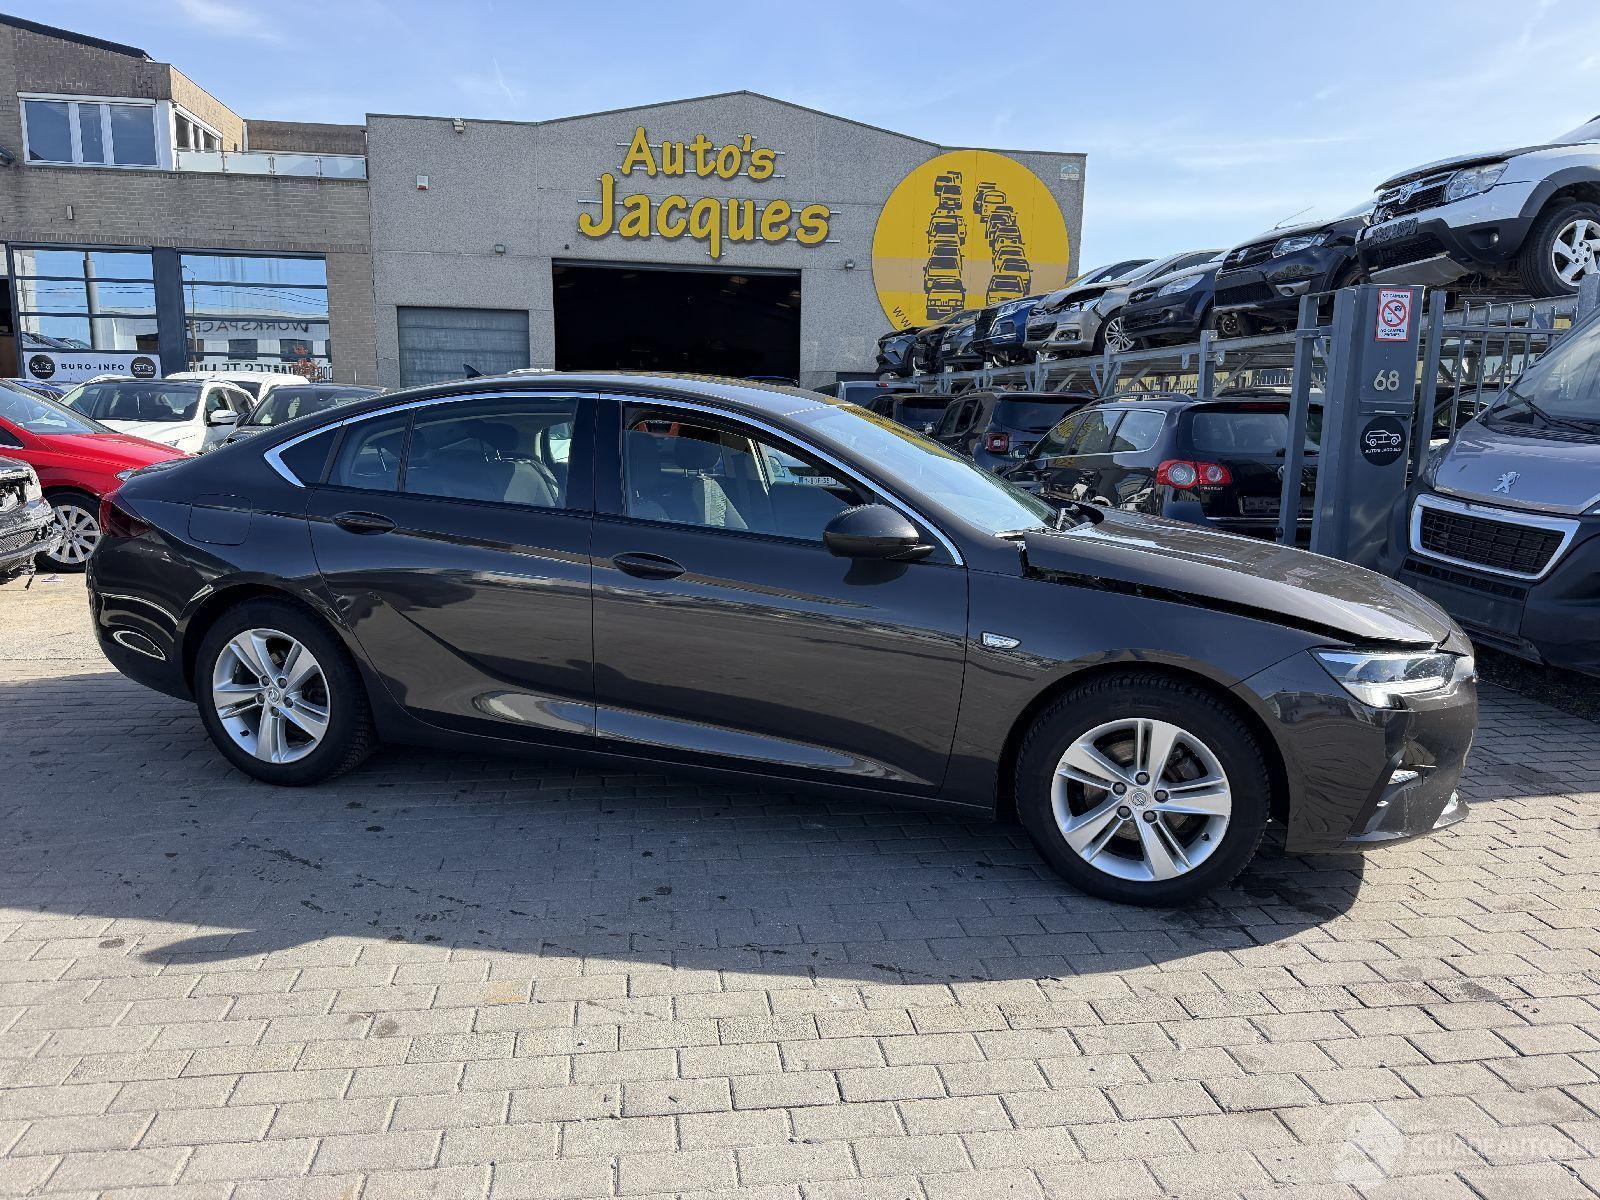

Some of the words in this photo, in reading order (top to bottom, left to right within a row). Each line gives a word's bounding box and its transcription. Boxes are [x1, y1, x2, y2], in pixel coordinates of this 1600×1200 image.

[621, 126, 776, 180] Auto's
[578, 172, 831, 259] Jacques
[61, 363, 125, 371] BURO-INFO
[1373, 369, 1400, 391] 68
